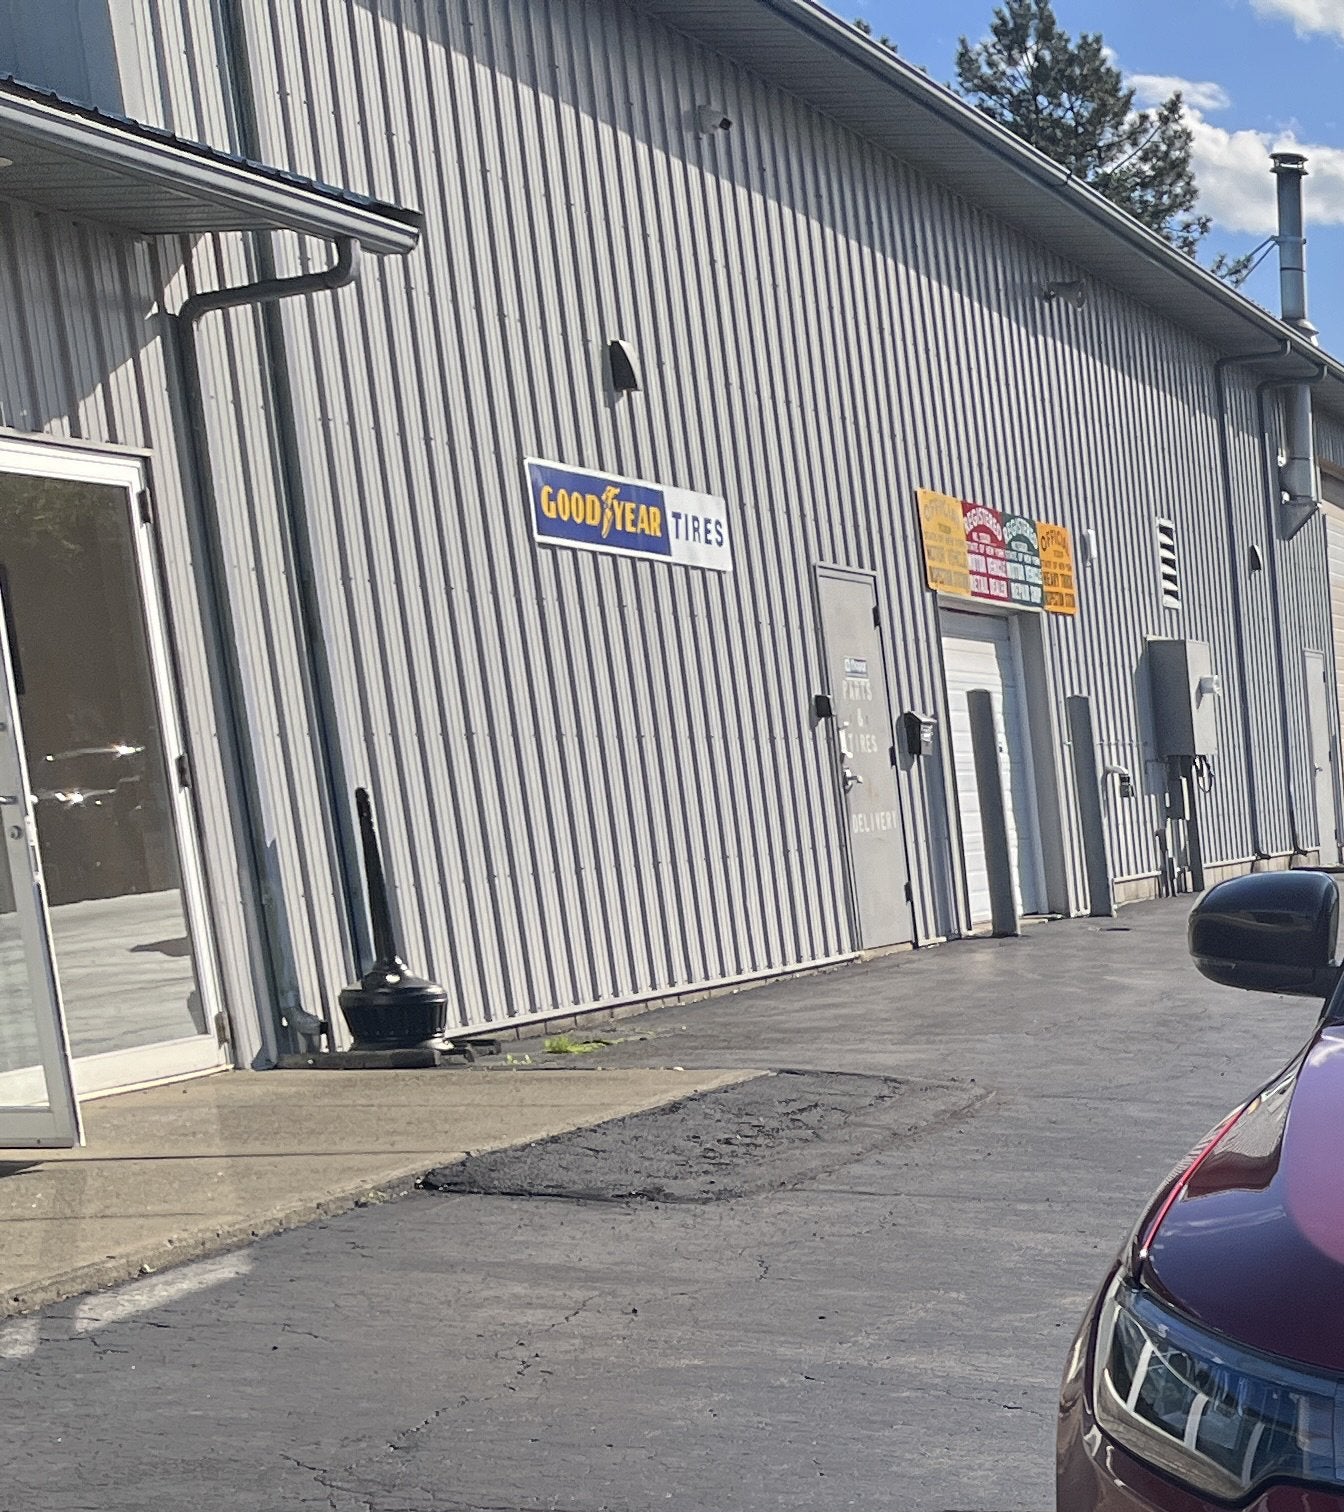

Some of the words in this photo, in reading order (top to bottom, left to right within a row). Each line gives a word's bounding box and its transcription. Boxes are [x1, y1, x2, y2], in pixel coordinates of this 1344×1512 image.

[540, 485, 662, 538] GOODYEAR
[672, 511, 724, 547] TIRES
[852, 811, 897, 834] DELIVERY
